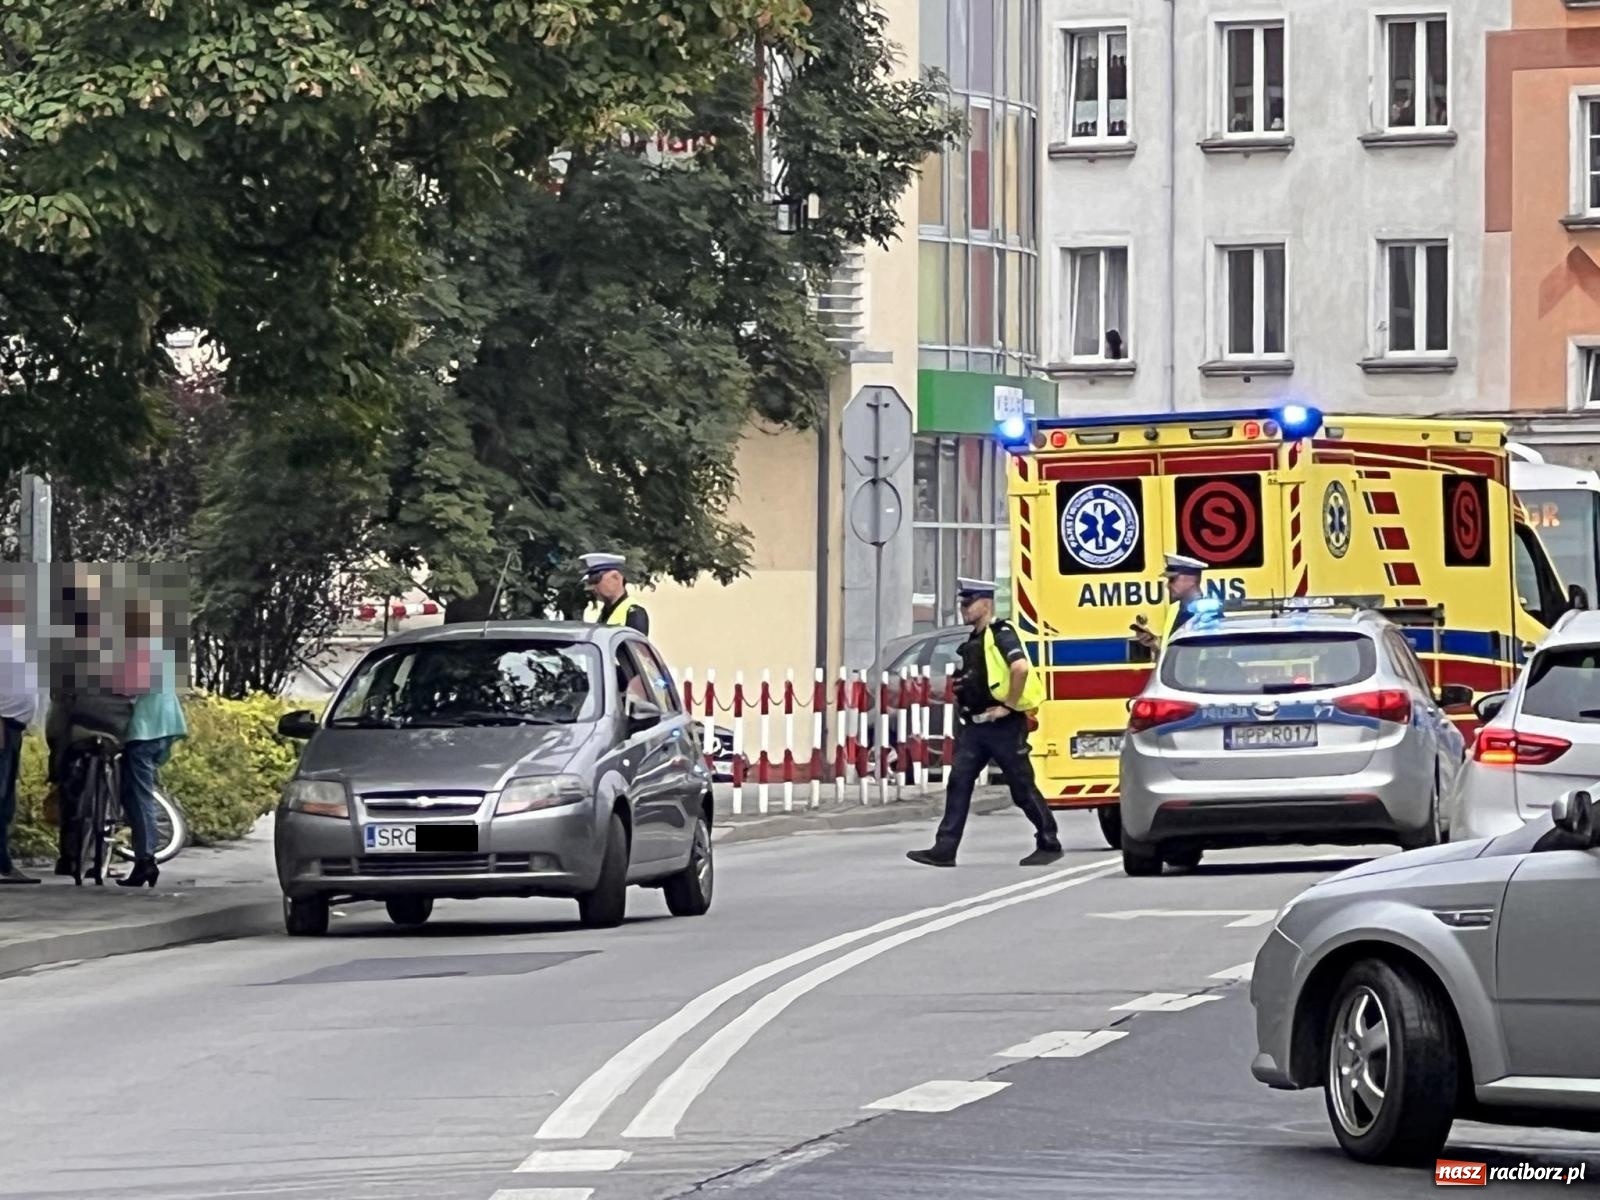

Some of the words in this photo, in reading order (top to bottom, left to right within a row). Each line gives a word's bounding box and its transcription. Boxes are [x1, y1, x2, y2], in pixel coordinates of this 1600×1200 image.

[1201, 497, 1236, 546] S
[1456, 495, 1474, 545] S
[1078, 577, 1247, 607] AMBUNS
[1271, 724, 1313, 742] R017
[378, 828, 417, 847] SRC
